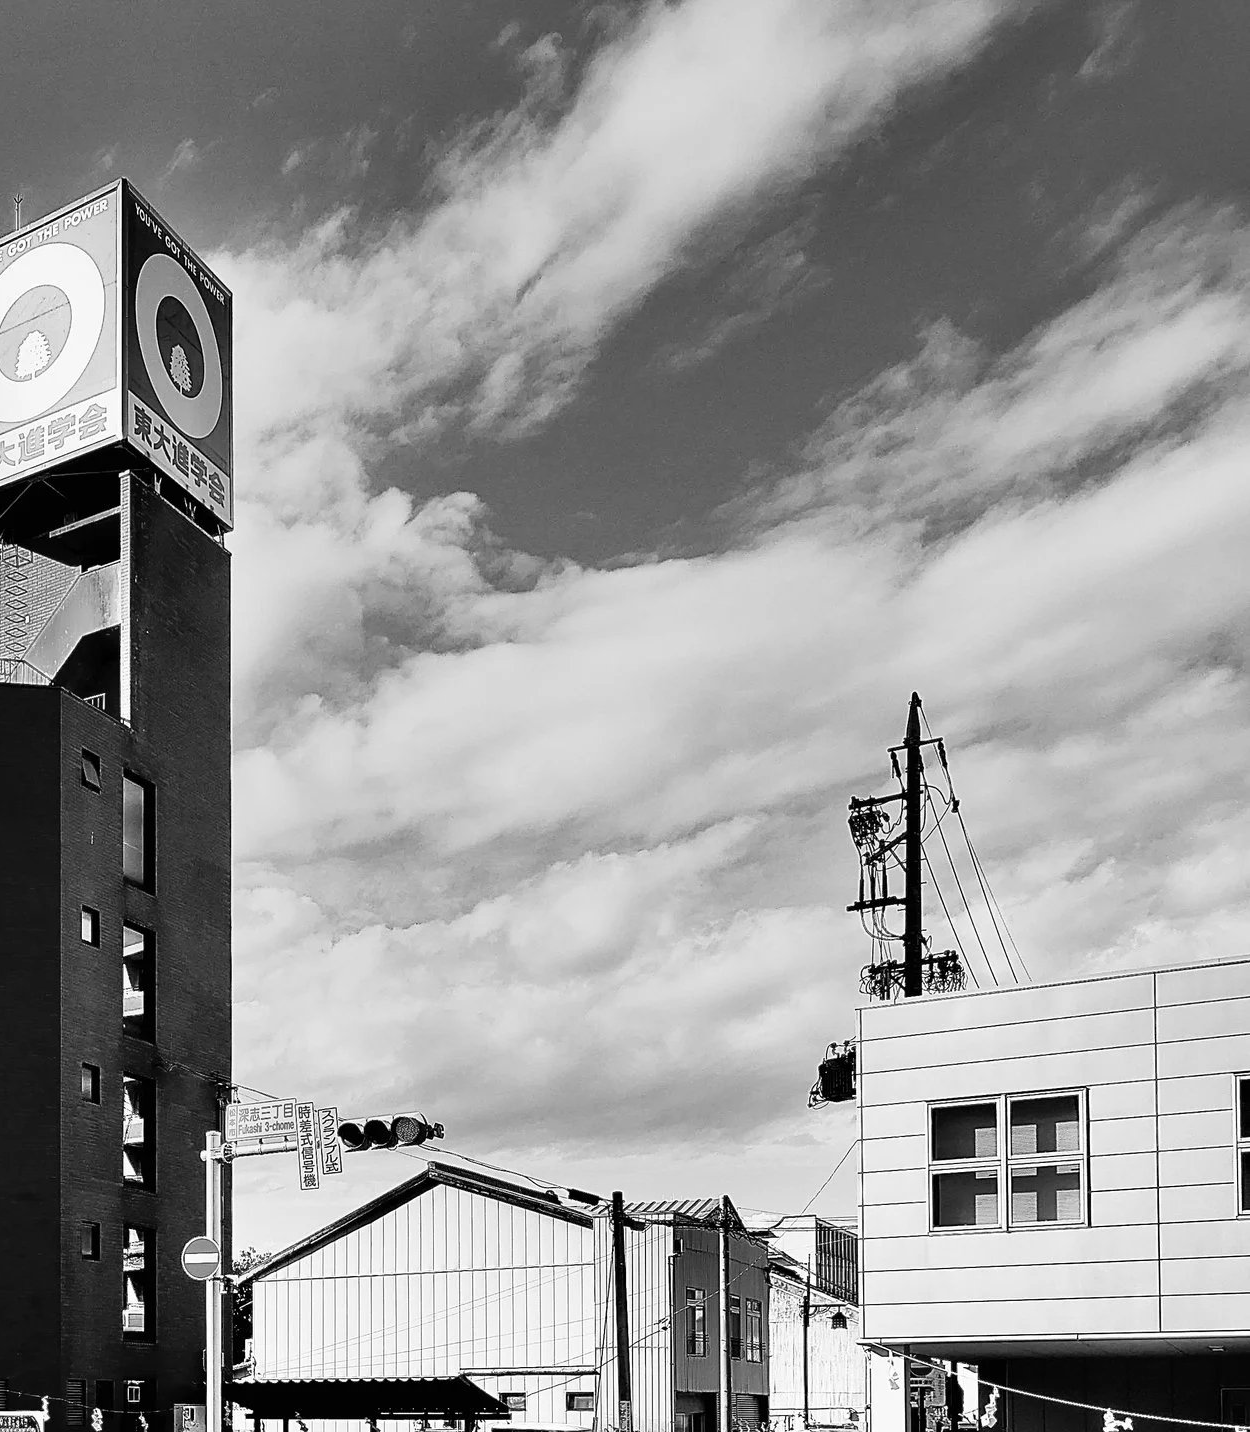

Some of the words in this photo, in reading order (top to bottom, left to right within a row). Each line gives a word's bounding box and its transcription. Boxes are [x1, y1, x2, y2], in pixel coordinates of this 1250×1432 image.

[7, 236, 33, 257] GOT
[37, 224, 60, 243] THE
[64, 199, 109, 231] POWER
[135, 202, 162, 240] YOU'VE
[165, 235, 181, 258] GOT
[183, 254, 197, 277] THE
[199, 271, 225, 306] POWER
[133, 403, 226, 509] 東大進学会
[238, 1103, 294, 1123] 深志三丁目
[238, 1121, 263, 1136] Fukashi
[264, 1121, 295, 1133] 3-chome
[322, 1110, 339, 1173] スクランブル式
[298, 1105, 317, 1187] 時差式信号機
